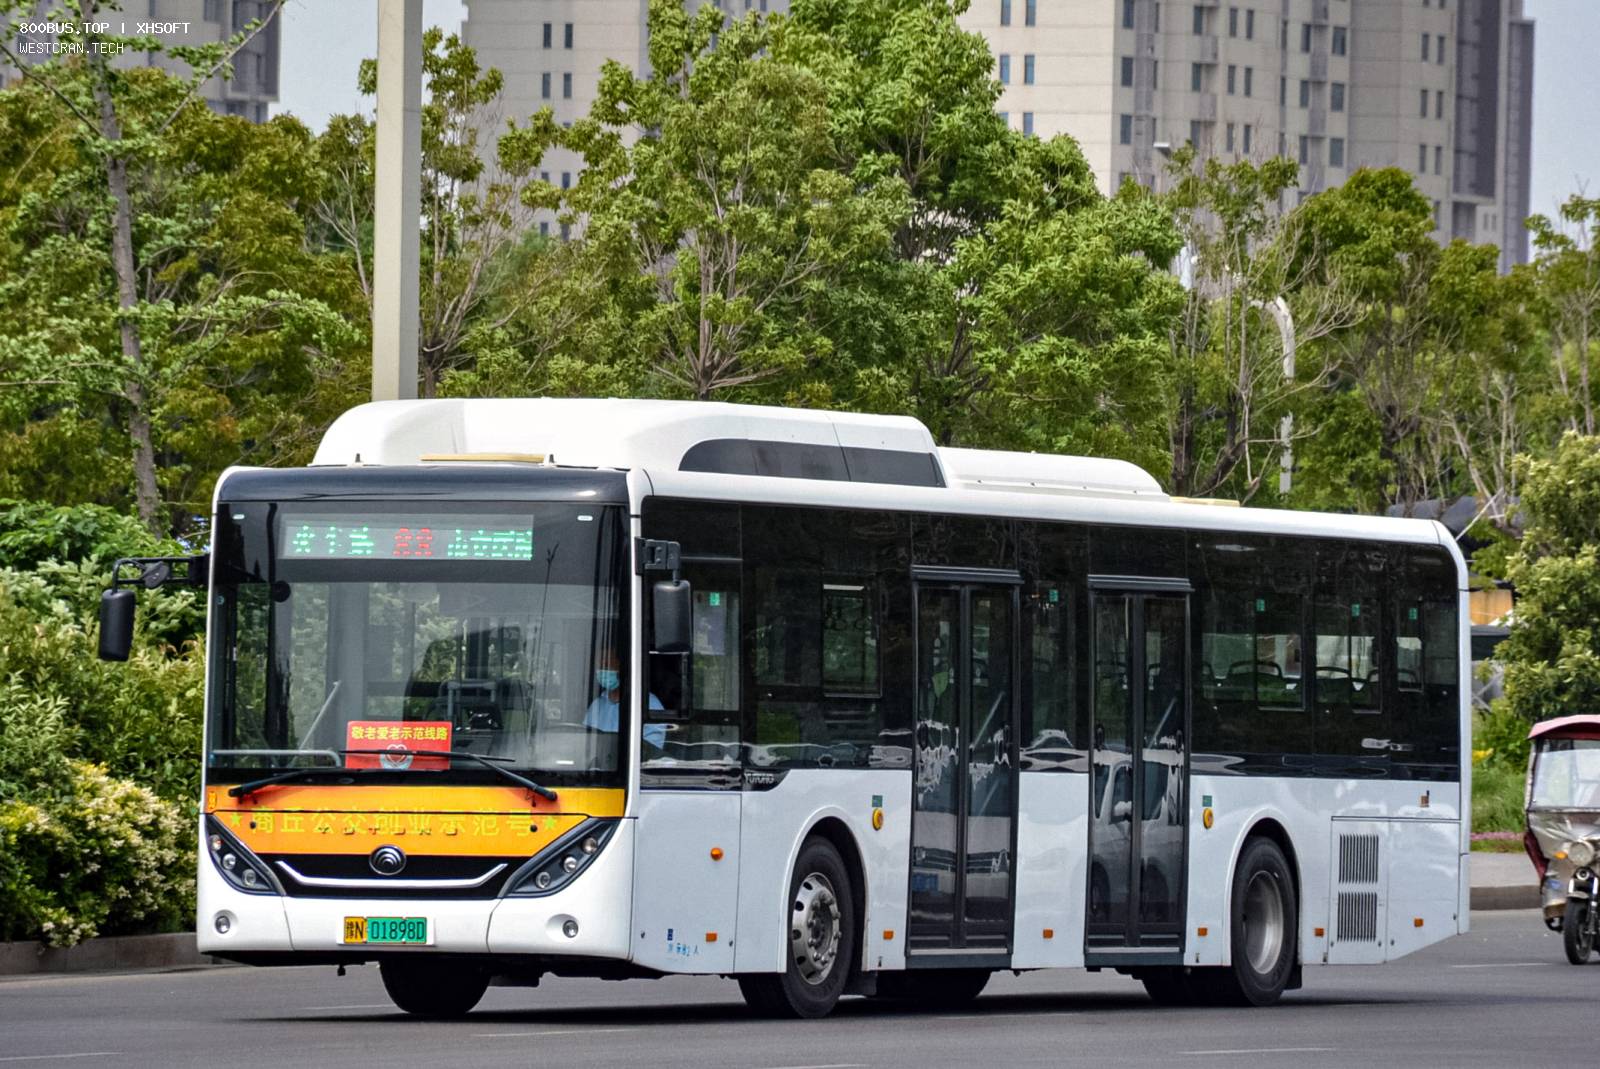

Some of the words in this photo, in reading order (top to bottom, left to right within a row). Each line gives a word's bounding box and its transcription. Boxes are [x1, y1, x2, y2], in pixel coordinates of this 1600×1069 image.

[351, 725, 448, 740] 敬老爱老示范线路
